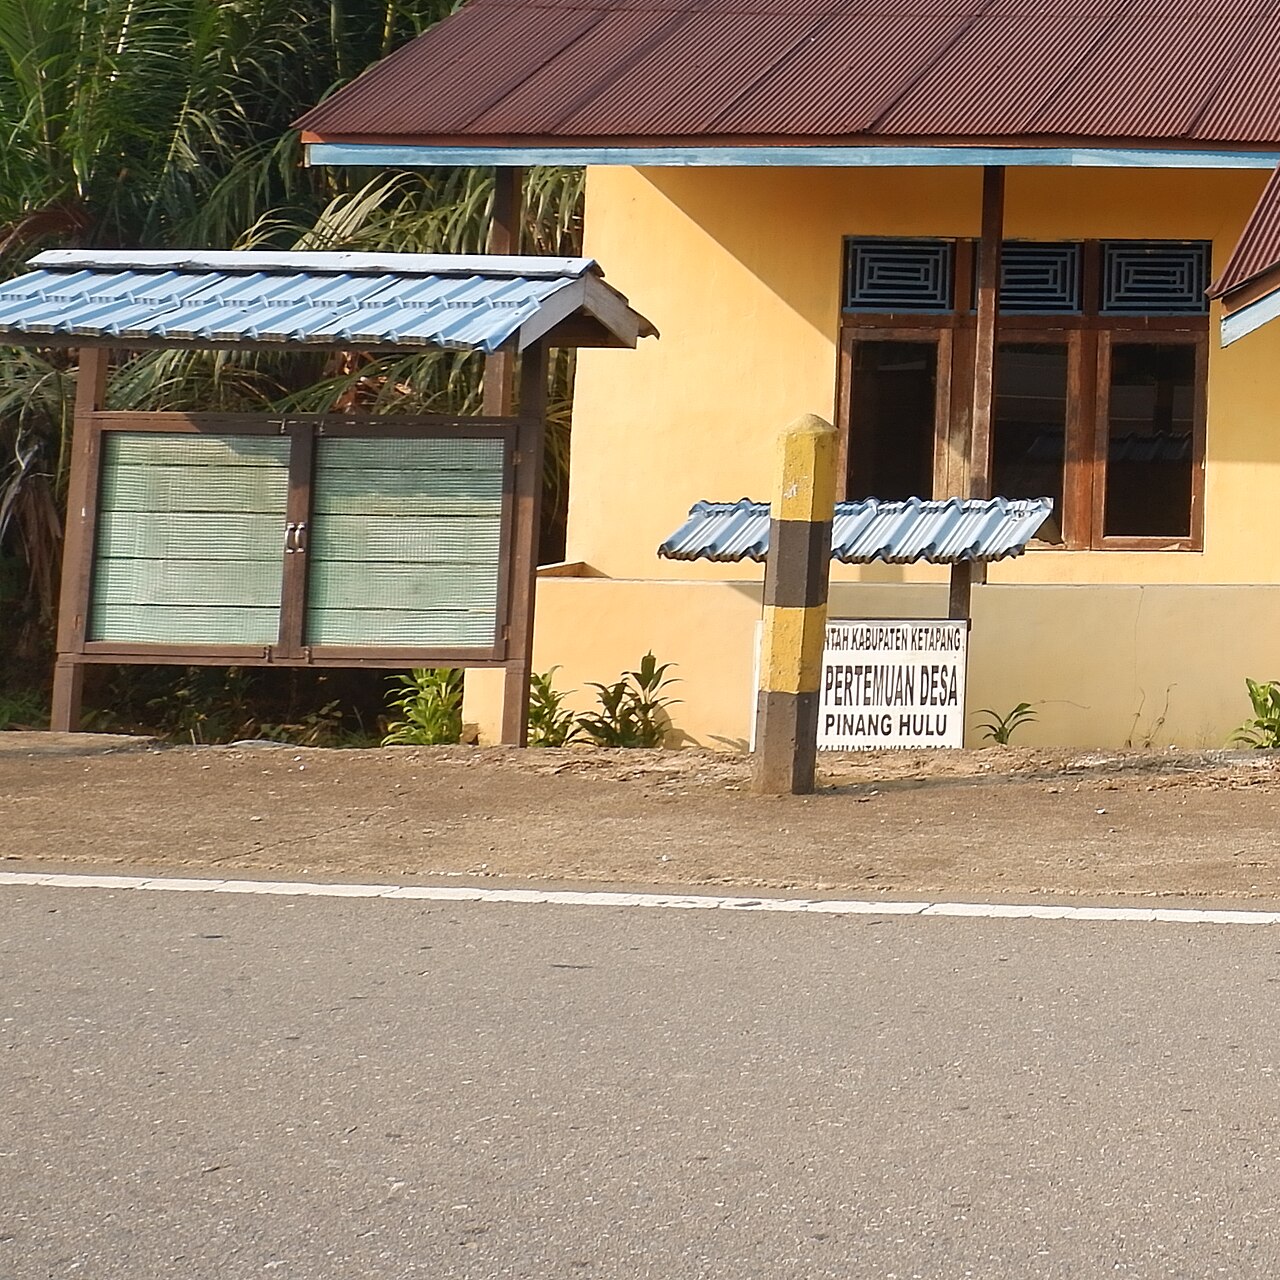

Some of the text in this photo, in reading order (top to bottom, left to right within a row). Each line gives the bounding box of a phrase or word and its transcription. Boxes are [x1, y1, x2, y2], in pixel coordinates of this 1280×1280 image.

[850, 628, 908, 651] KABUPATEN
[911, 628, 961, 651] KETAPANG
[825, 665, 957, 706] PERTEMUAN DESA
[825, 714, 947, 736] PINANG HULU
